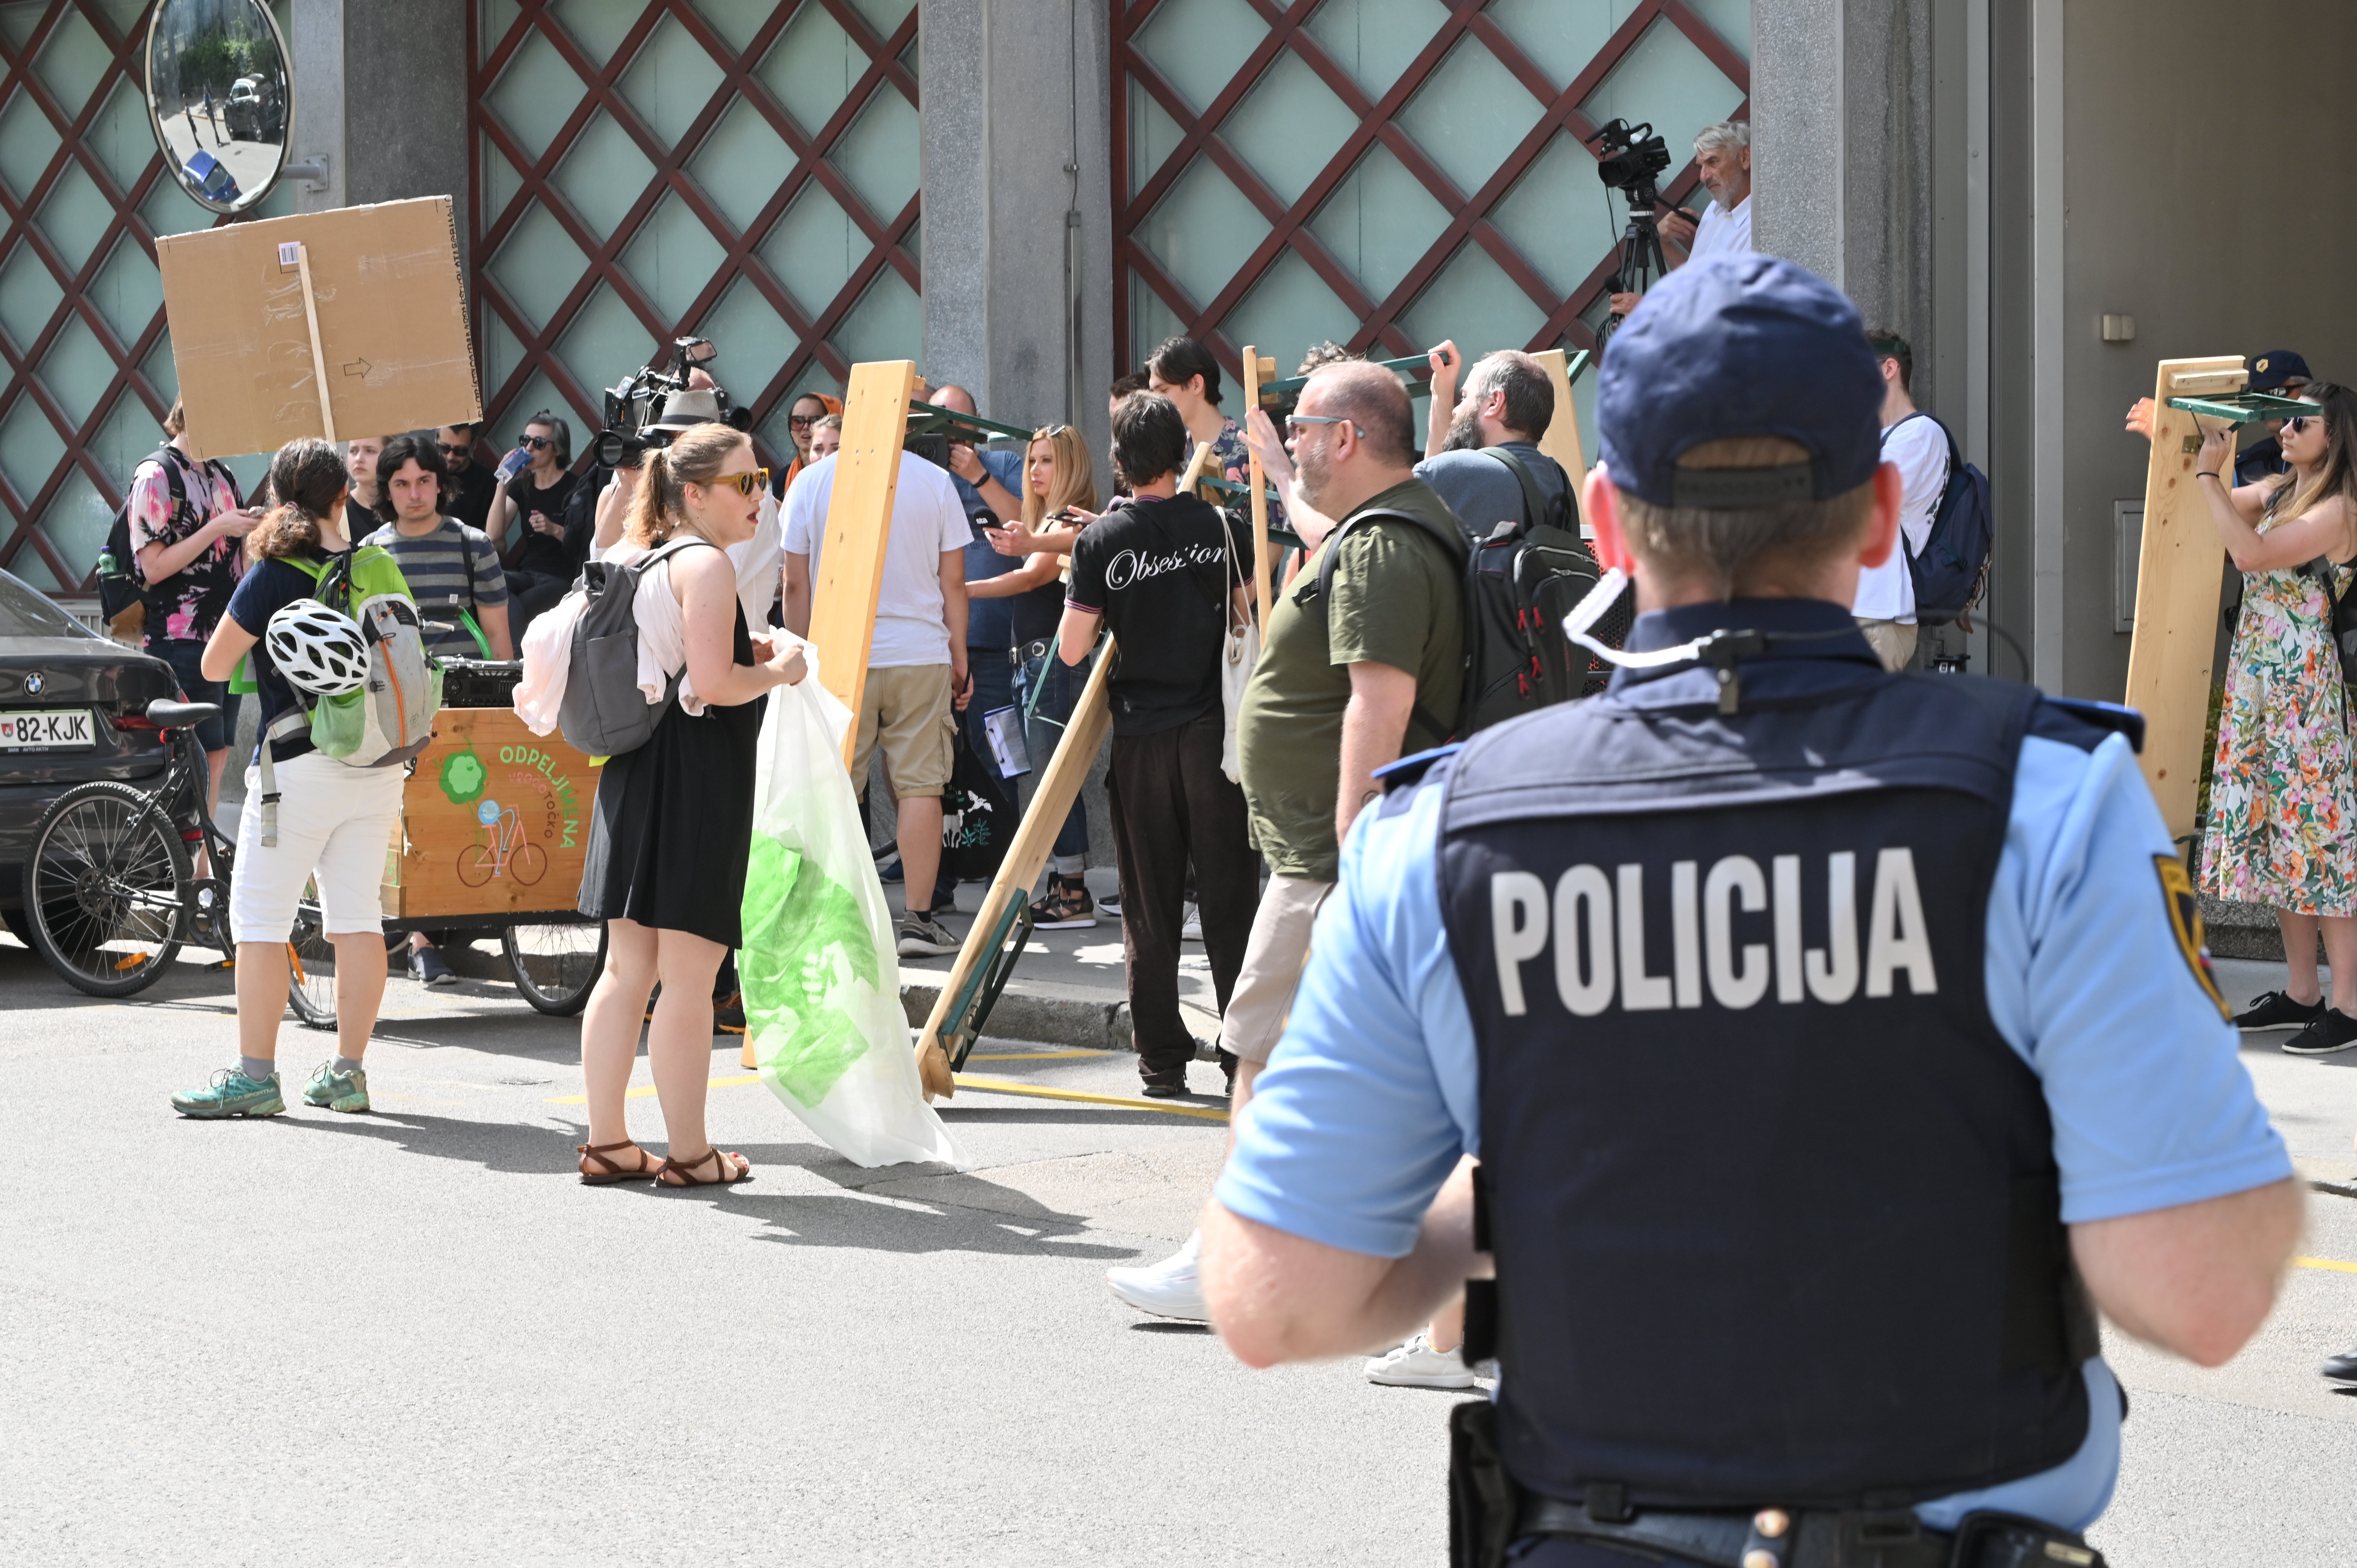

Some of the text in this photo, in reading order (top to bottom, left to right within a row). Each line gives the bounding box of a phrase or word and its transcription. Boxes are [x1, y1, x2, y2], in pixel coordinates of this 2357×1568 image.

[16, 717, 88, 742] 82-KJK
[1491, 847, 1938, 1016] POLICIJA
[244, 1087, 276, 1098] SPORTIVA
